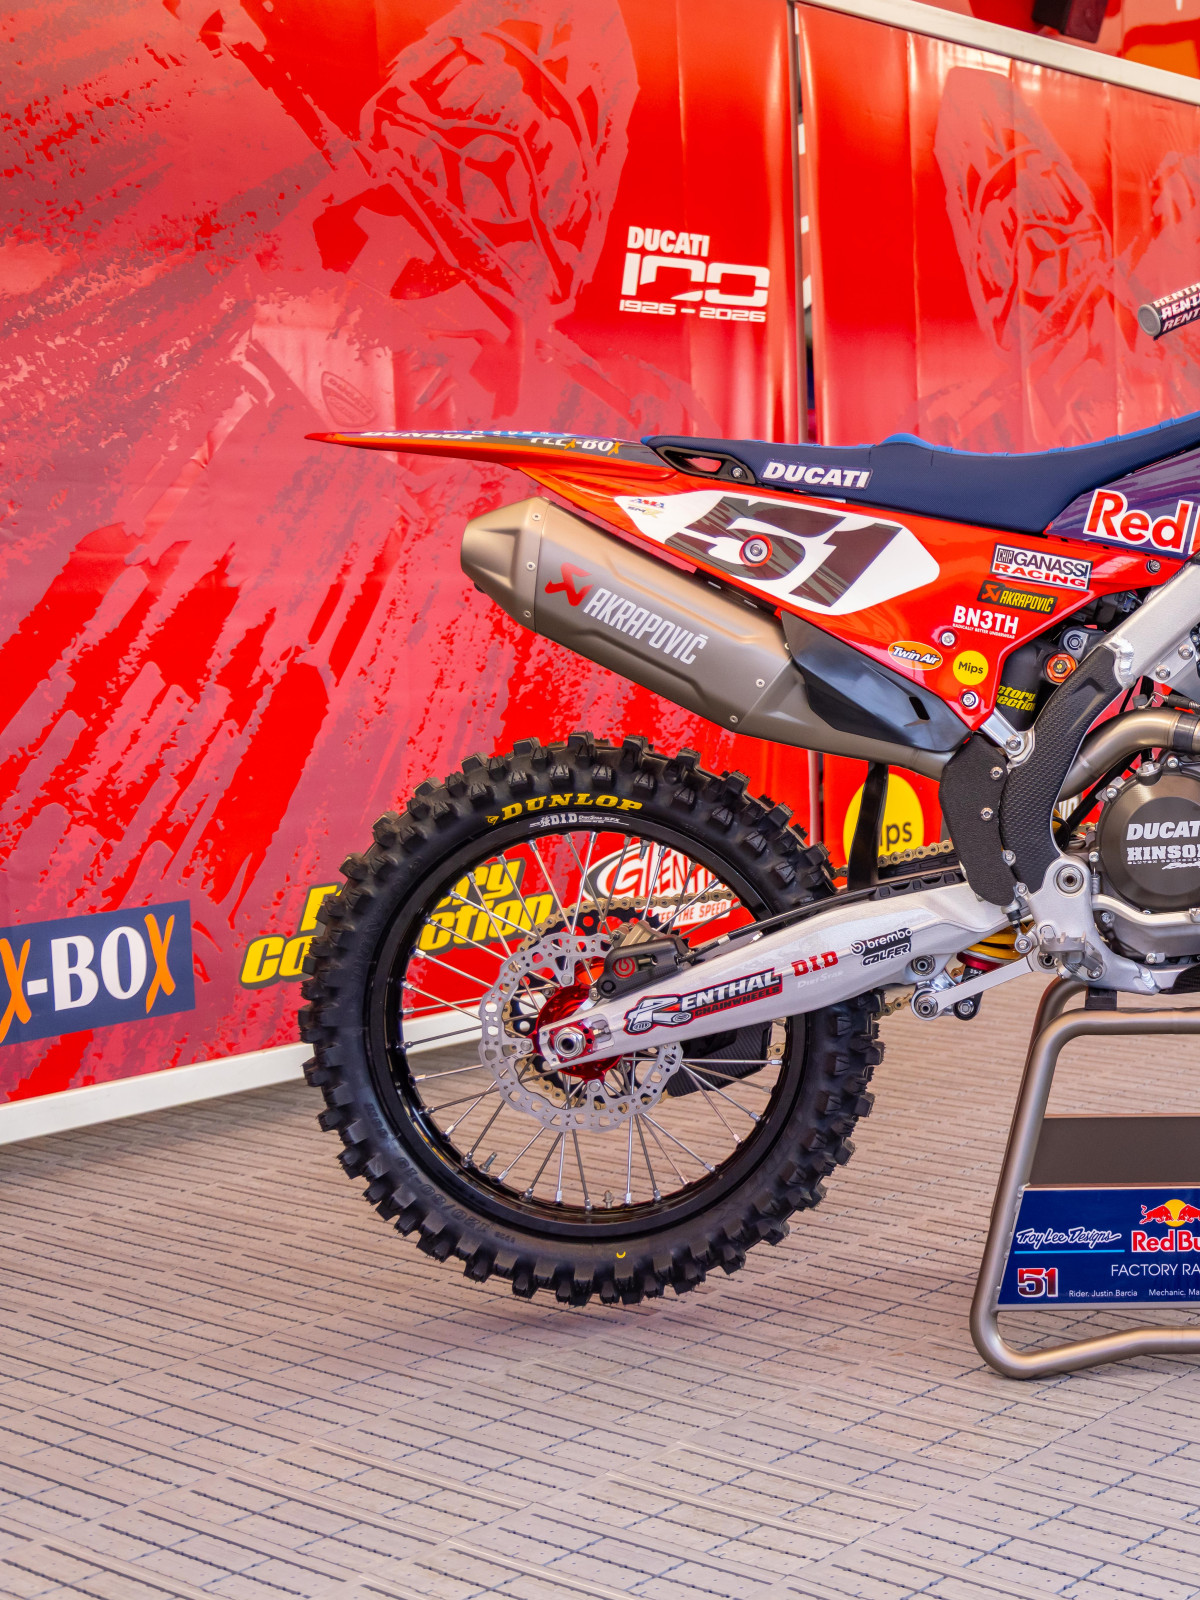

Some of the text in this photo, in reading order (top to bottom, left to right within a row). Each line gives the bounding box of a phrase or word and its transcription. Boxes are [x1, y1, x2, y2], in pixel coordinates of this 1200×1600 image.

[627, 225, 710, 257] DUCATI
[619, 299, 676, 315] 1926
[699, 307, 766, 322] 2026
[763, 462, 870, 488] DUCATI
[1083, 488, 1194, 553] Red
[664, 496, 903, 607] 51
[997, 548, 1089, 578] CHIP GANASSI
[994, 563, 1086, 588] RACING
[583, 587, 709, 665] AKRAPOVIČ
[953, 605, 1019, 634] BN3TH
[892, 647, 940, 666] Twin Air
[958, 661, 984, 675] Mips
[998, 685, 1036, 702] ctory
[501, 793, 643, 820] DUNLOP
[700, 902, 727, 918] SPEED
[867, 929, 913, 949] brembo
[791, 951, 838, 976] D.I.D
[862, 943, 911, 967] GALFER
[694, 986, 780, 1017] CHAINWHEELS
[1016, 1228, 1044, 1250] Troy
[1043, 1228, 1068, 1244] Lee
[1067, 1226, 1122, 1249] Designs
[1131, 1229, 1175, 1253] Red
[1018, 1267, 1058, 1297] 51
[1111, 1263, 1178, 1277] FACTORY
[1091, 1289, 1113, 1298] Justin
[1115, 1288, 1138, 1297] Barcia
